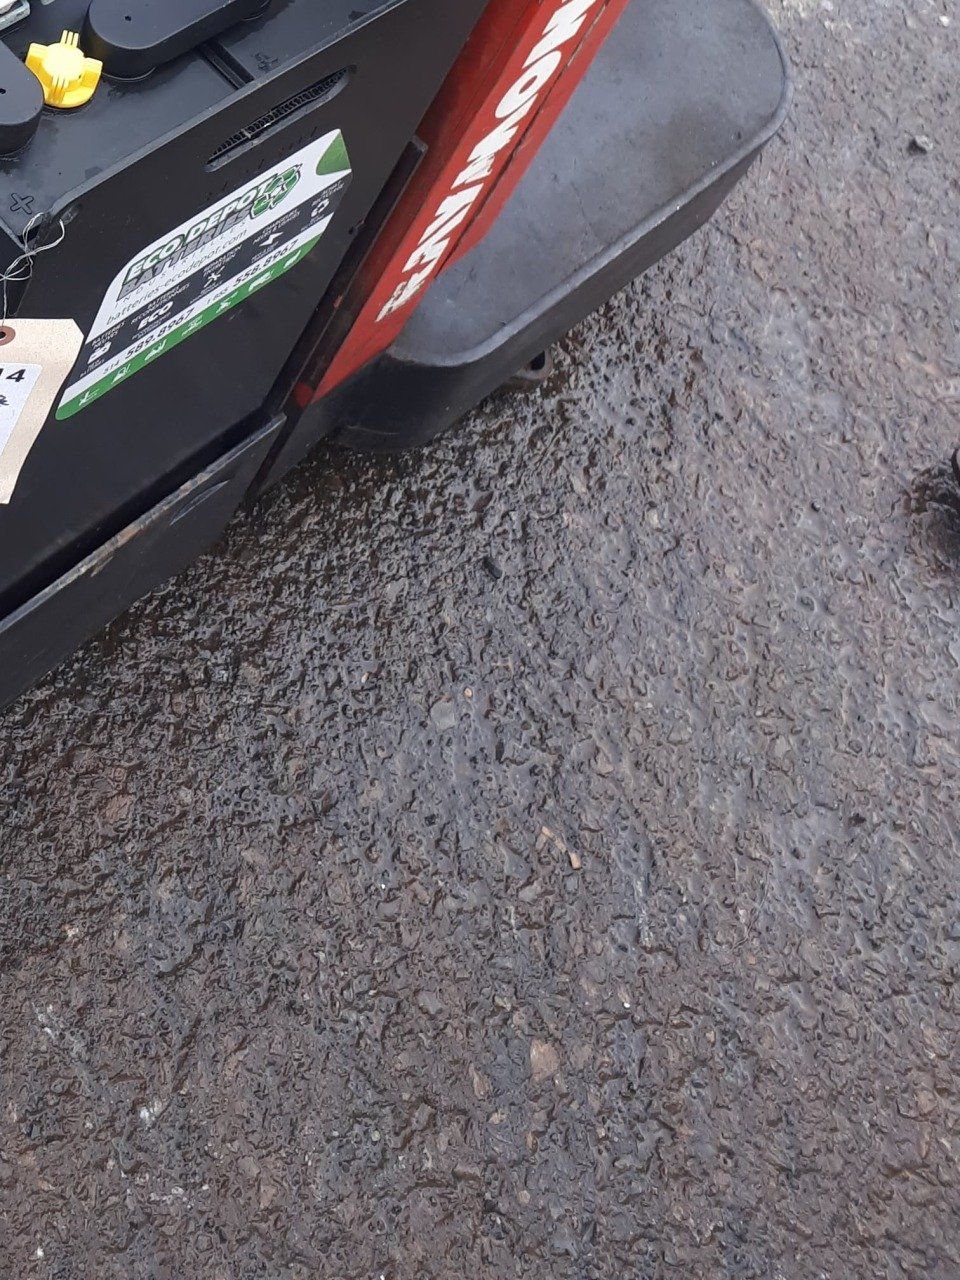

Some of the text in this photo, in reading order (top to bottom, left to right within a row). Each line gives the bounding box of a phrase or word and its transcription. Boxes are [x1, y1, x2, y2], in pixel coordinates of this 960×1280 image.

[106, 229, 247, 326] batteries-ecodepot.com
[116, 204, 253, 303] BATTERIES
[124, 173, 279, 285] ECO DEPOT
[125, 306, 195, 360] 589.8967
[233, 237, 299, 288] 558.8967
[138, 300, 174, 331] ECO
